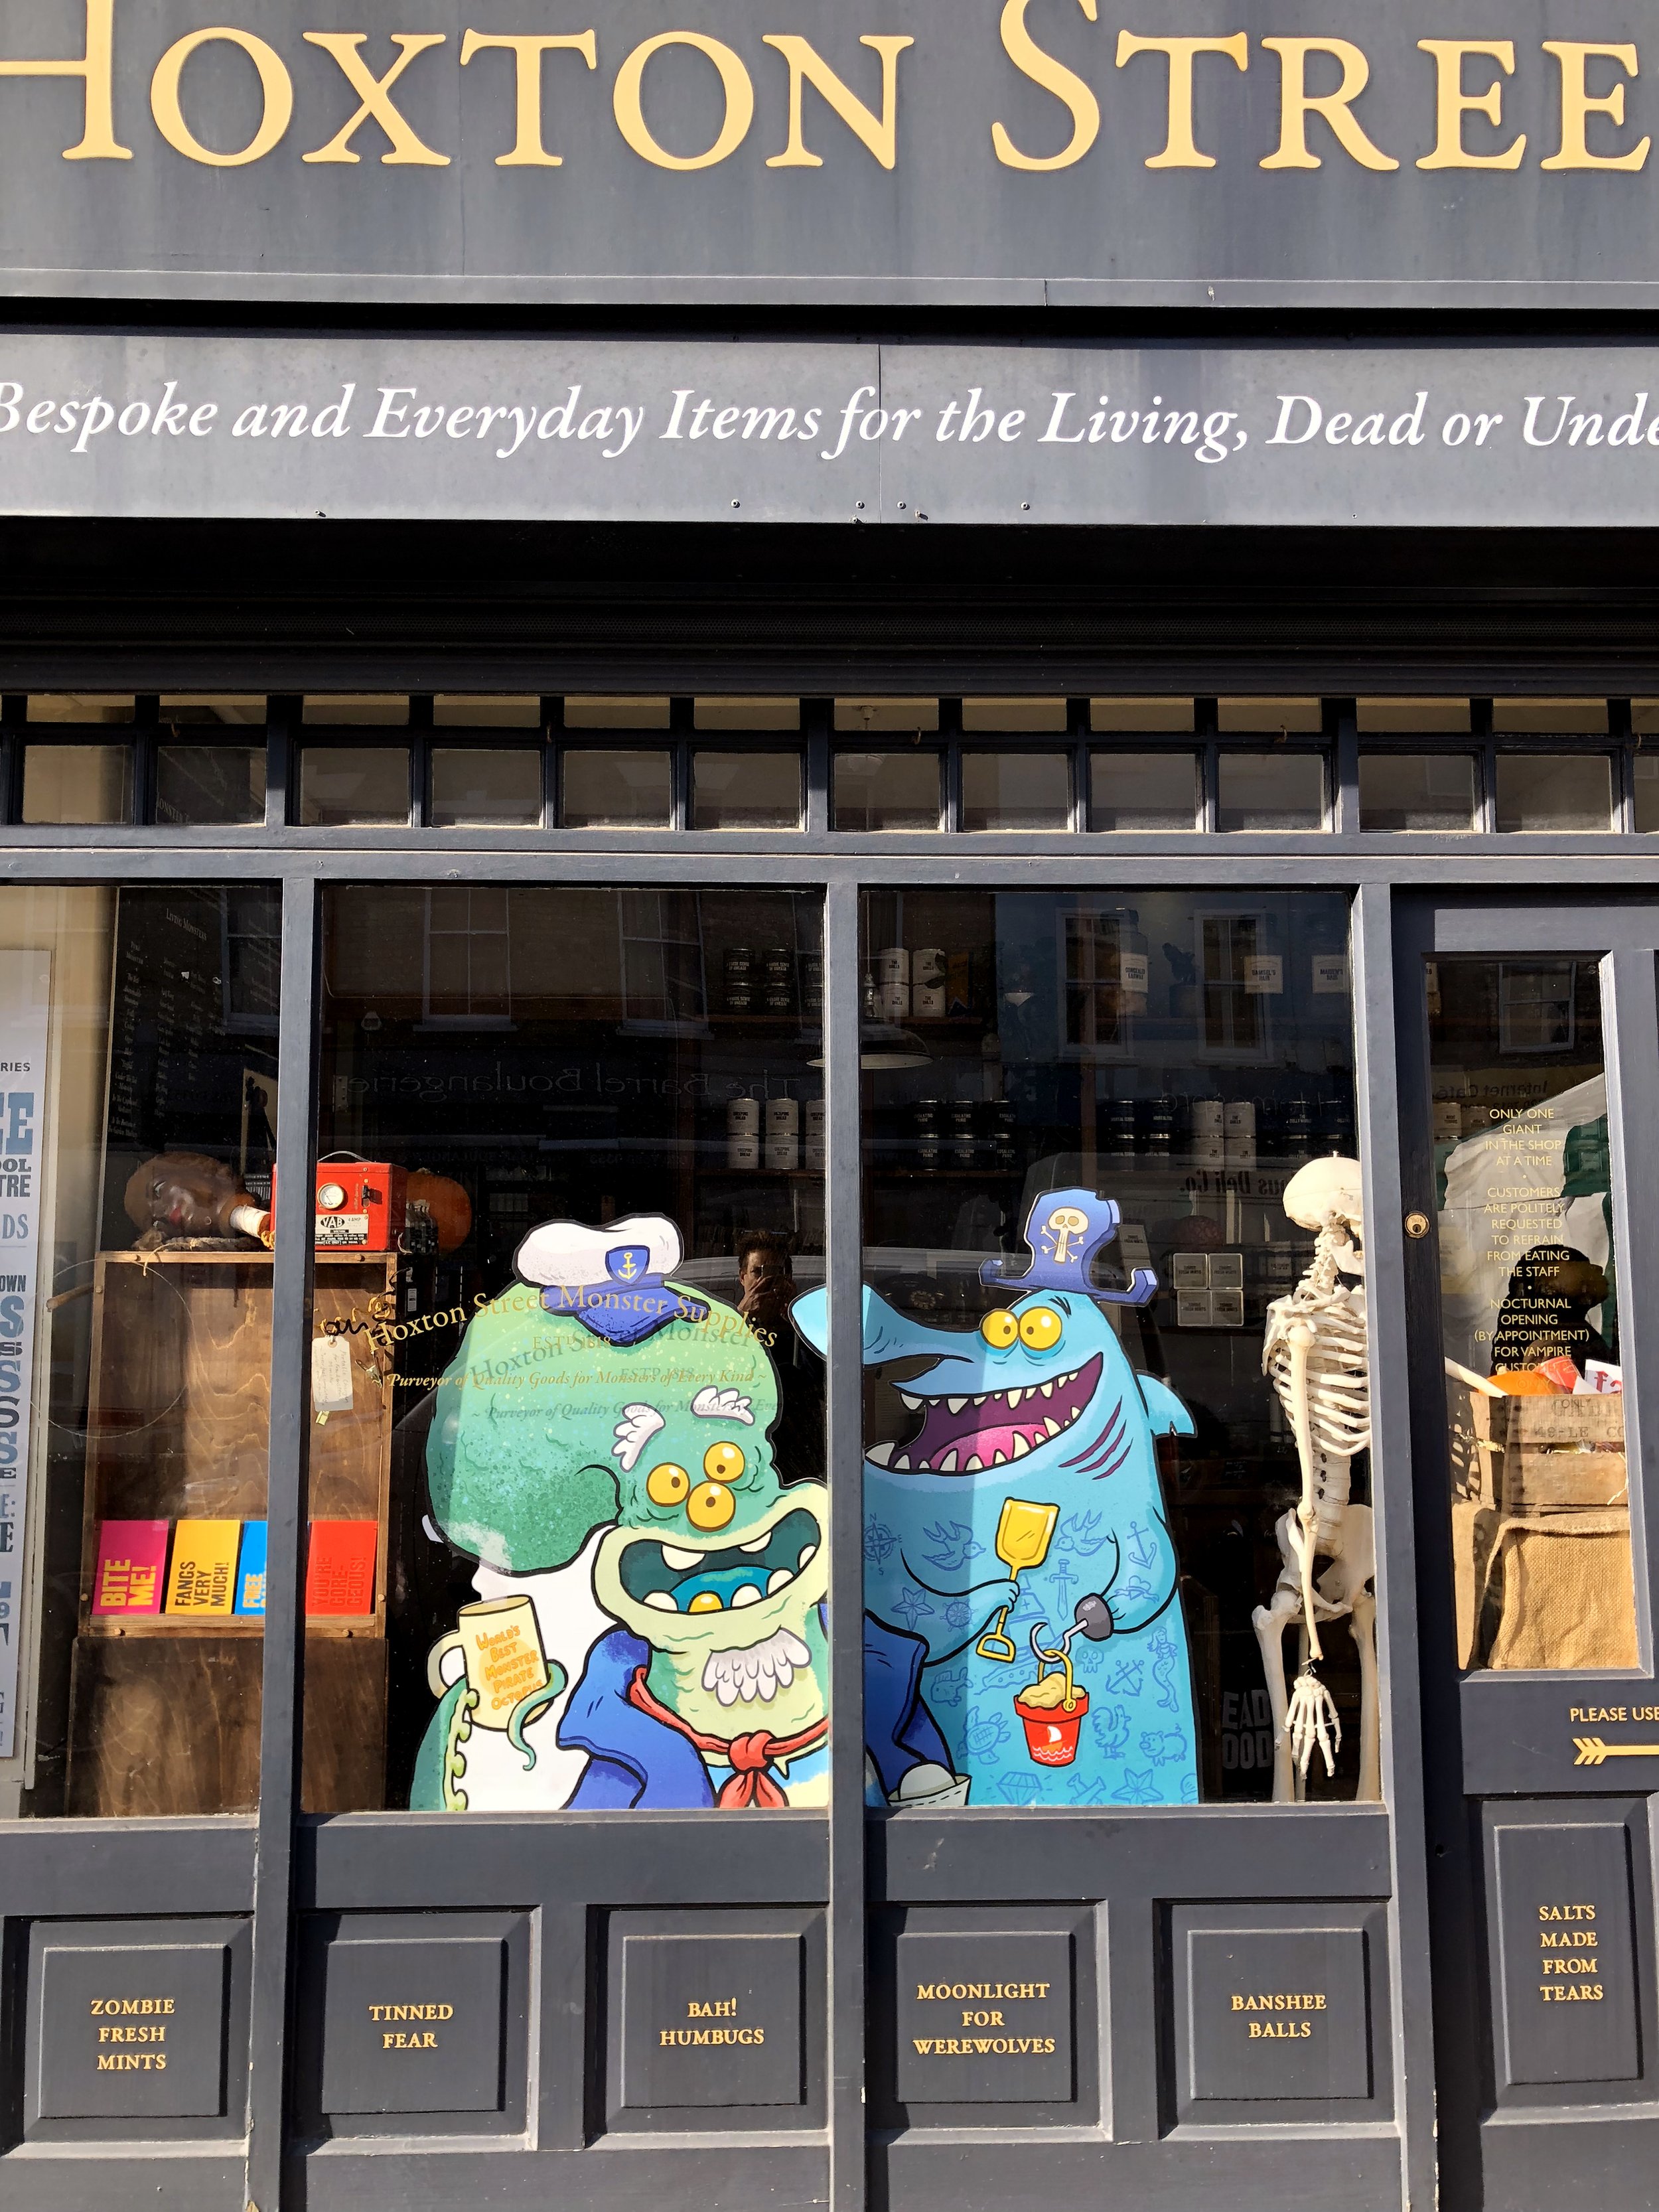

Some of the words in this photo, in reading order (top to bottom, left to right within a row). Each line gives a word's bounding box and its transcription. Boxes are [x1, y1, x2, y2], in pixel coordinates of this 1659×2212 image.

[993, 0, 1650, 171] STREE
[0, 382, 218, 453] Bespoke
[233, 384, 356, 438] and
[364, 386, 644, 459] Everyday
[660, 390, 822, 439] Items
[816, 387, 922, 460] for
[937, 388, 1025, 443] the
[1039, 394, 1248, 463] Living,
[1266, 392, 1429, 445] Dead
[1443, 415, 1504, 449] or
[1489, 1108, 1523, 1119] ONLY
[1527, 1108, 1554, 1119] ONE
[0, 1092, 35, 1155] E
[1502, 1124, 1542, 1134] GIANT
[1485, 1140, 1498, 1149] IN
[1501, 1140, 1524, 1149] THE
[1528, 1140, 1561, 1150] SHOP
[0, 1158, 31, 1173] OL
[1496, 1156, 1511, 1165] AT
[1514, 1156, 1522, 1165] A
[1524, 1156, 1552, 1165] TIME
[1487, 1187, 1561, 1198] CUSTOMERS
[1483, 1203, 1507, 1213] ARE
[1511, 1203, 1565, 1213] POLITELY
[321, 1216, 344, 1228] VAB
[1492, 1219, 1562, 1230] REQUESTED
[1491, 1235, 1508, 1245] TO
[1513, 1235, 1563, 1245] REFRAIN
[1487, 1251, 1520, 1261] FROM
[1525, 1250, 1569, 1261] EATING
[1498, 1266, 1522, 1276] THE
[1526, 1266, 1560, 1276] STAFF
[1490, 1299, 1571, 1309] NOCTURNAL
[364, 1306, 467, 1353] Hoxton
[473, 1292, 550, 1317] Street
[557, 1285, 668, 1314] Monster
[674, 1293, 778, 1347] Supplies
[1500, 1315, 1558, 1325] OPENING
[1475, 1329, 1493, 1342] (BY
[1496, 1329, 1590, 1342] APPOINTMENT)
[1494, 1347, 1519, 1357] FOR
[1521, 1346, 1571, 1357] VAMPIRE
[386, 1373, 453, 1390] Purveyor
[455, 1373, 470, 1390] of
[472, 1372, 525, 1390] Quality
[529, 1371, 569, 1386] Goods
[570, 1370, 592, 1388] for
[595, 1371, 656, 1384] Monsters
[660, 1371, 676, 1388] of
[678, 1370, 715, 1386] Every
[720, 1369, 755, 1382] Kind
[100, 1559, 131, 1606] BITE
[128, 1566, 157, 1606] ME!
[175, 1561, 196, 1606] FANGS
[192, 1570, 212, 1606] VERY
[210, 1562, 230, 1607] MUCH!
[312, 1557, 332, 1606] YOU'RE
[329, 1565, 348, 1606] GORE-
[346, 1557, 367, 1606] GEOUS!
[242, 1574, 263, 1607] FREE
[475, 1625, 521, 1651] WORLD'S
[490, 1642, 518, 1662] BEST
[484, 1650, 540, 1681] MONSTER
[493, 1666, 534, 1693] PIRATE
[1571, 1709, 1626, 1722] PLEASE
[1633, 1708, 1659, 1722] USE
[1540, 1906, 1595, 1921] SALTS
[1542, 1933, 1597, 1948] MADE
[1544, 1960, 1597, 1975] FROM
[918, 1984, 1049, 2000] MOONLIGHT
[1541, 1986, 1603, 2002] TEARS
[92, 2000, 173, 2016] ZOMBIE
[689, 2000, 736, 2018] BAH!
[1232, 1996, 1325, 2012] BANSHEE
[370, 2006, 453, 2022] TINNED
[964, 2012, 1003, 2027] FOR
[100, 2028, 165, 2043] FRESH
[662, 2029, 764, 2047] HUMBUGS
[1250, 2024, 1311, 2039] BALLS
[384, 2033, 436, 2049] FEAR
[914, 2039, 1054, 2055] WEREWOLVES
[99, 2055, 166, 2071] MINTS
